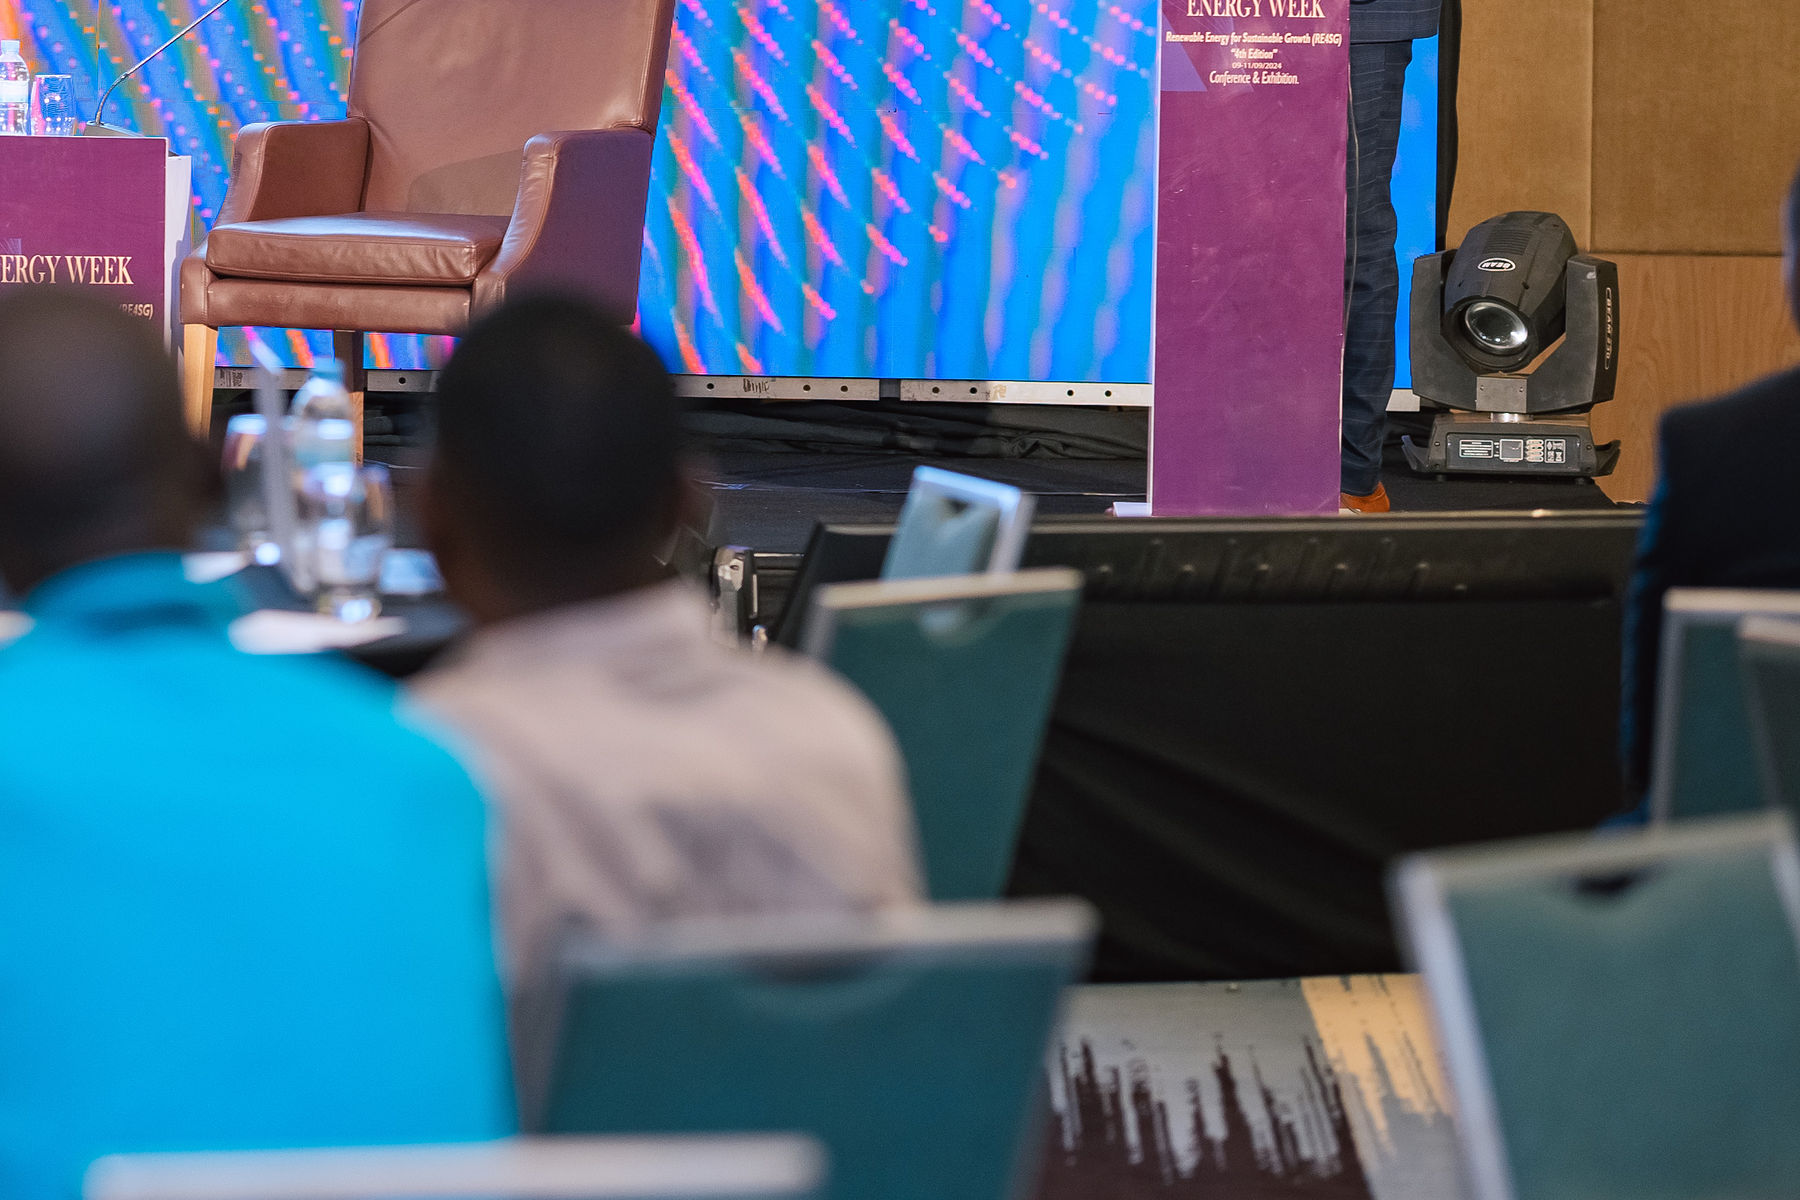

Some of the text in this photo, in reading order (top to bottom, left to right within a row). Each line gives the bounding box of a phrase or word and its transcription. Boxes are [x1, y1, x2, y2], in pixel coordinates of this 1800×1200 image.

[1166, 31, 1204, 43] Renewable
[1205, 31, 1229, 46] Energy
[1231, 32, 1241, 45] for
[1242, 32, 1283, 44] Sustainable
[1284, 33, 1311, 44] Growth
[1210, 70, 1251, 86] Conference
[65, 255, 134, 285] WEEK
